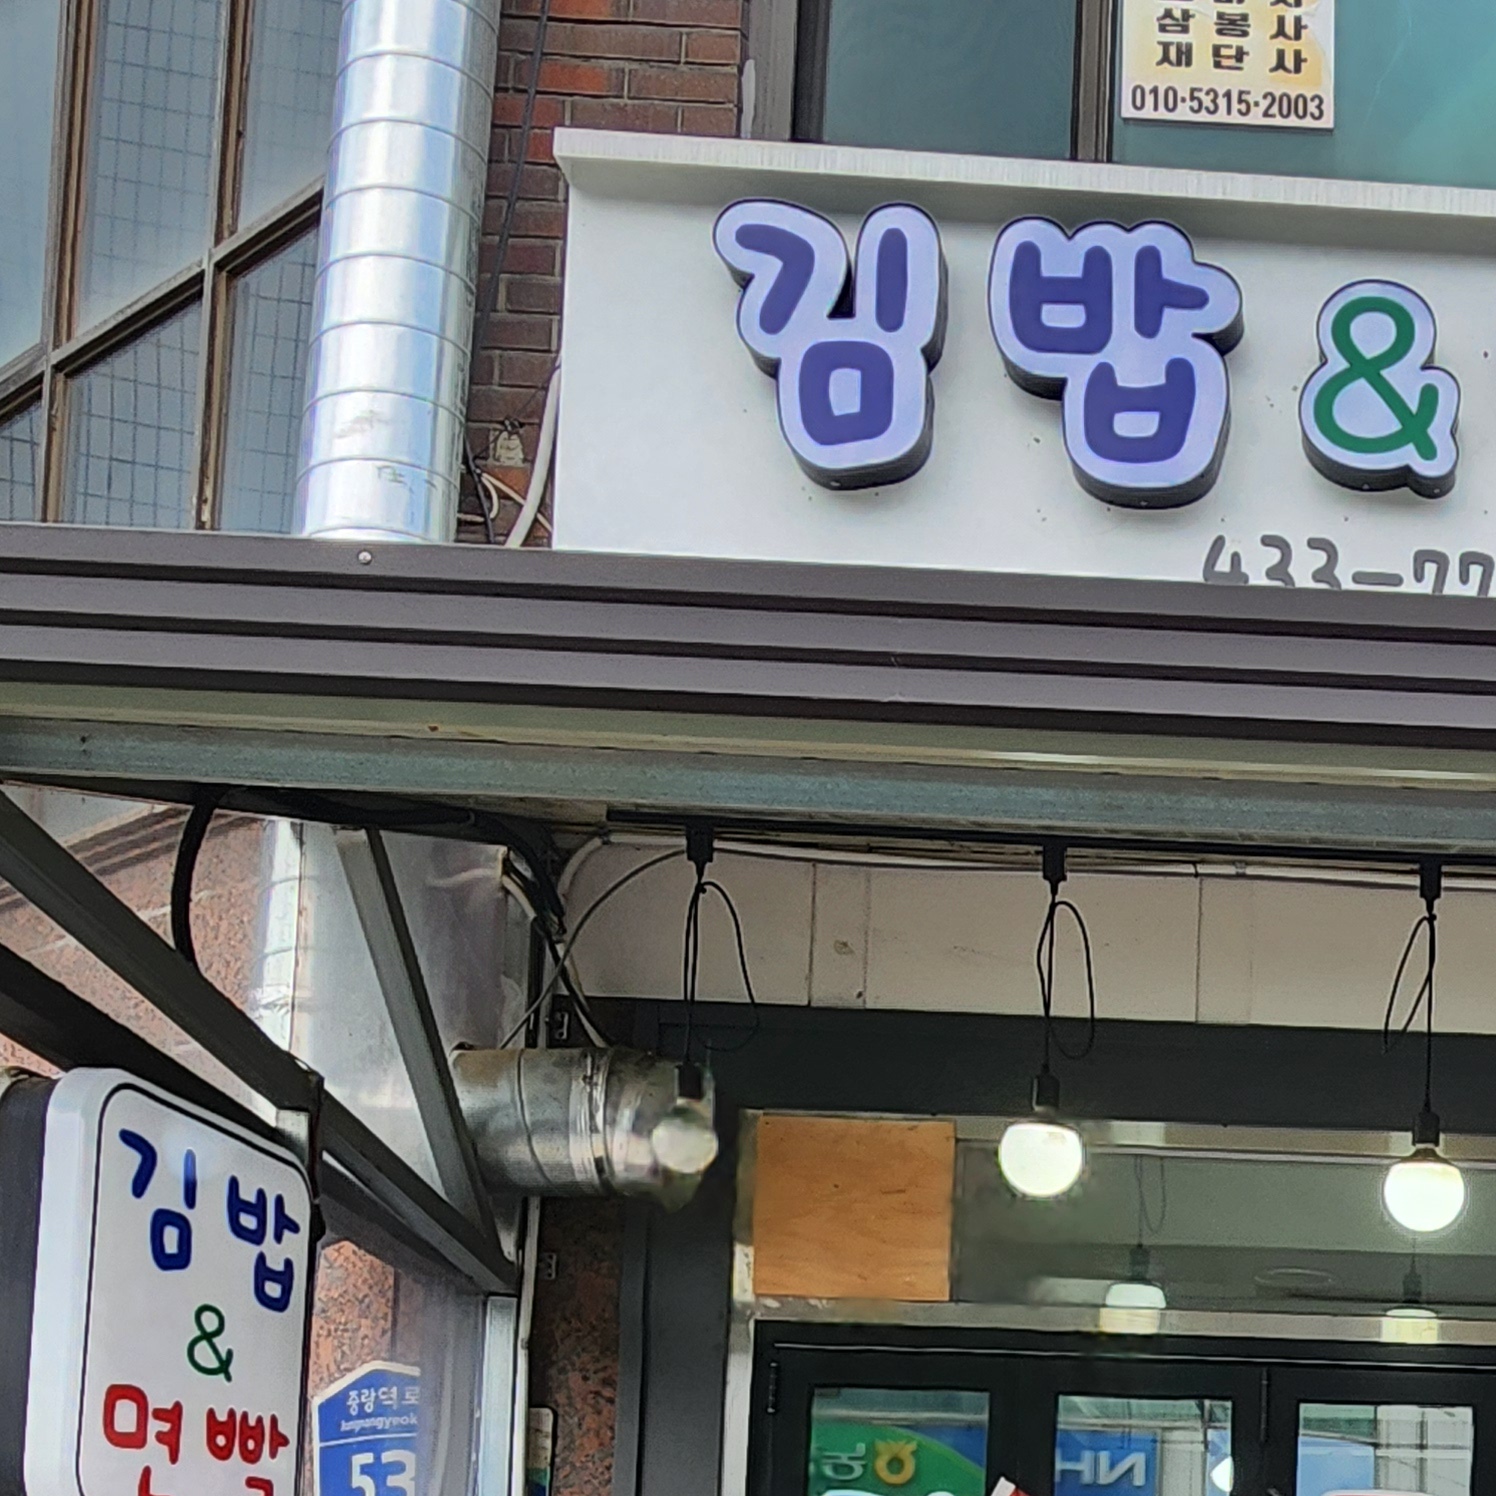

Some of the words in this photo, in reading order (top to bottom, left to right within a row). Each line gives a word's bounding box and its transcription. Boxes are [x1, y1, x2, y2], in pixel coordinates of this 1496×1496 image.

[1156, 41, 1308, 74] 재단사
[730, 219, 1214, 470] 김밥
[1312, 293, 1440, 463] &
[118, 1128, 301, 1313] 김밥
[186, 1303, 234, 1383] &
